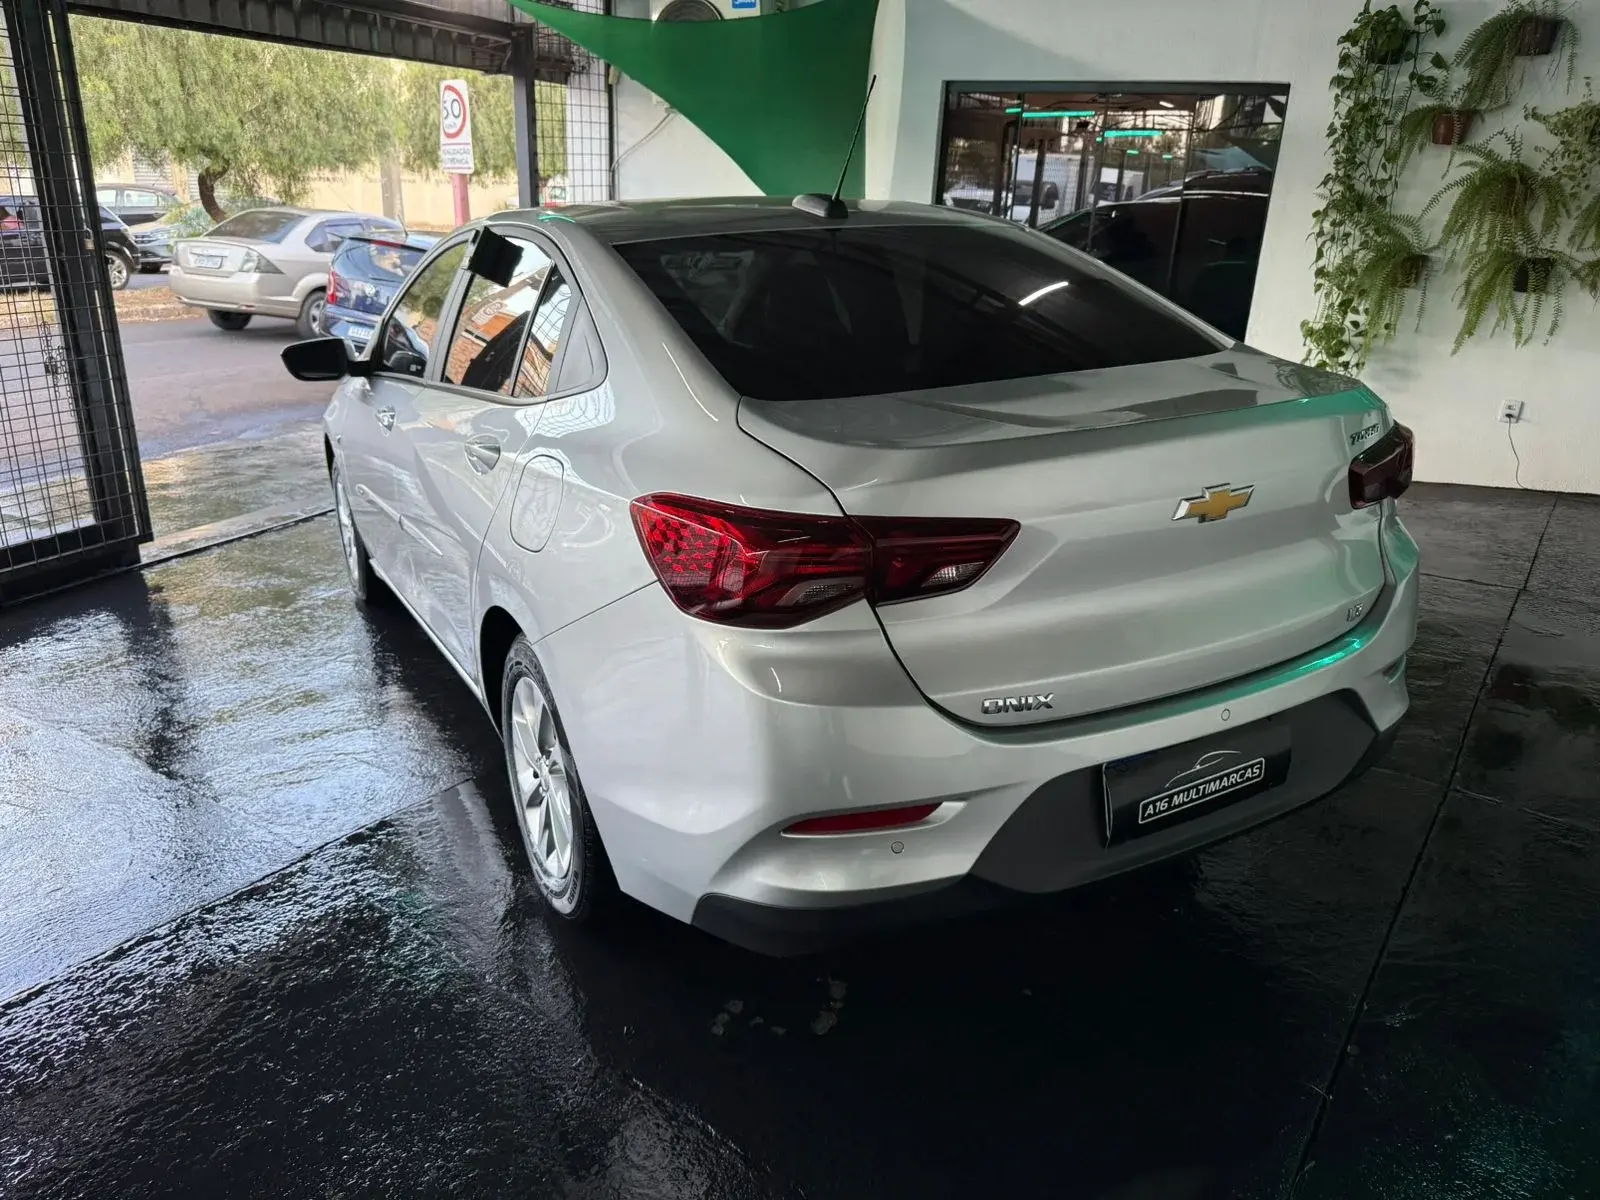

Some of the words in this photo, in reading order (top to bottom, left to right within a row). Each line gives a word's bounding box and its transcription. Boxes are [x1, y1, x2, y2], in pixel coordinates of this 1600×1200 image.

[981, 693, 1054, 714] ONIX
[1144, 798, 1168, 817] A16
[1171, 764, 1261, 807] MULTIMARCAS
